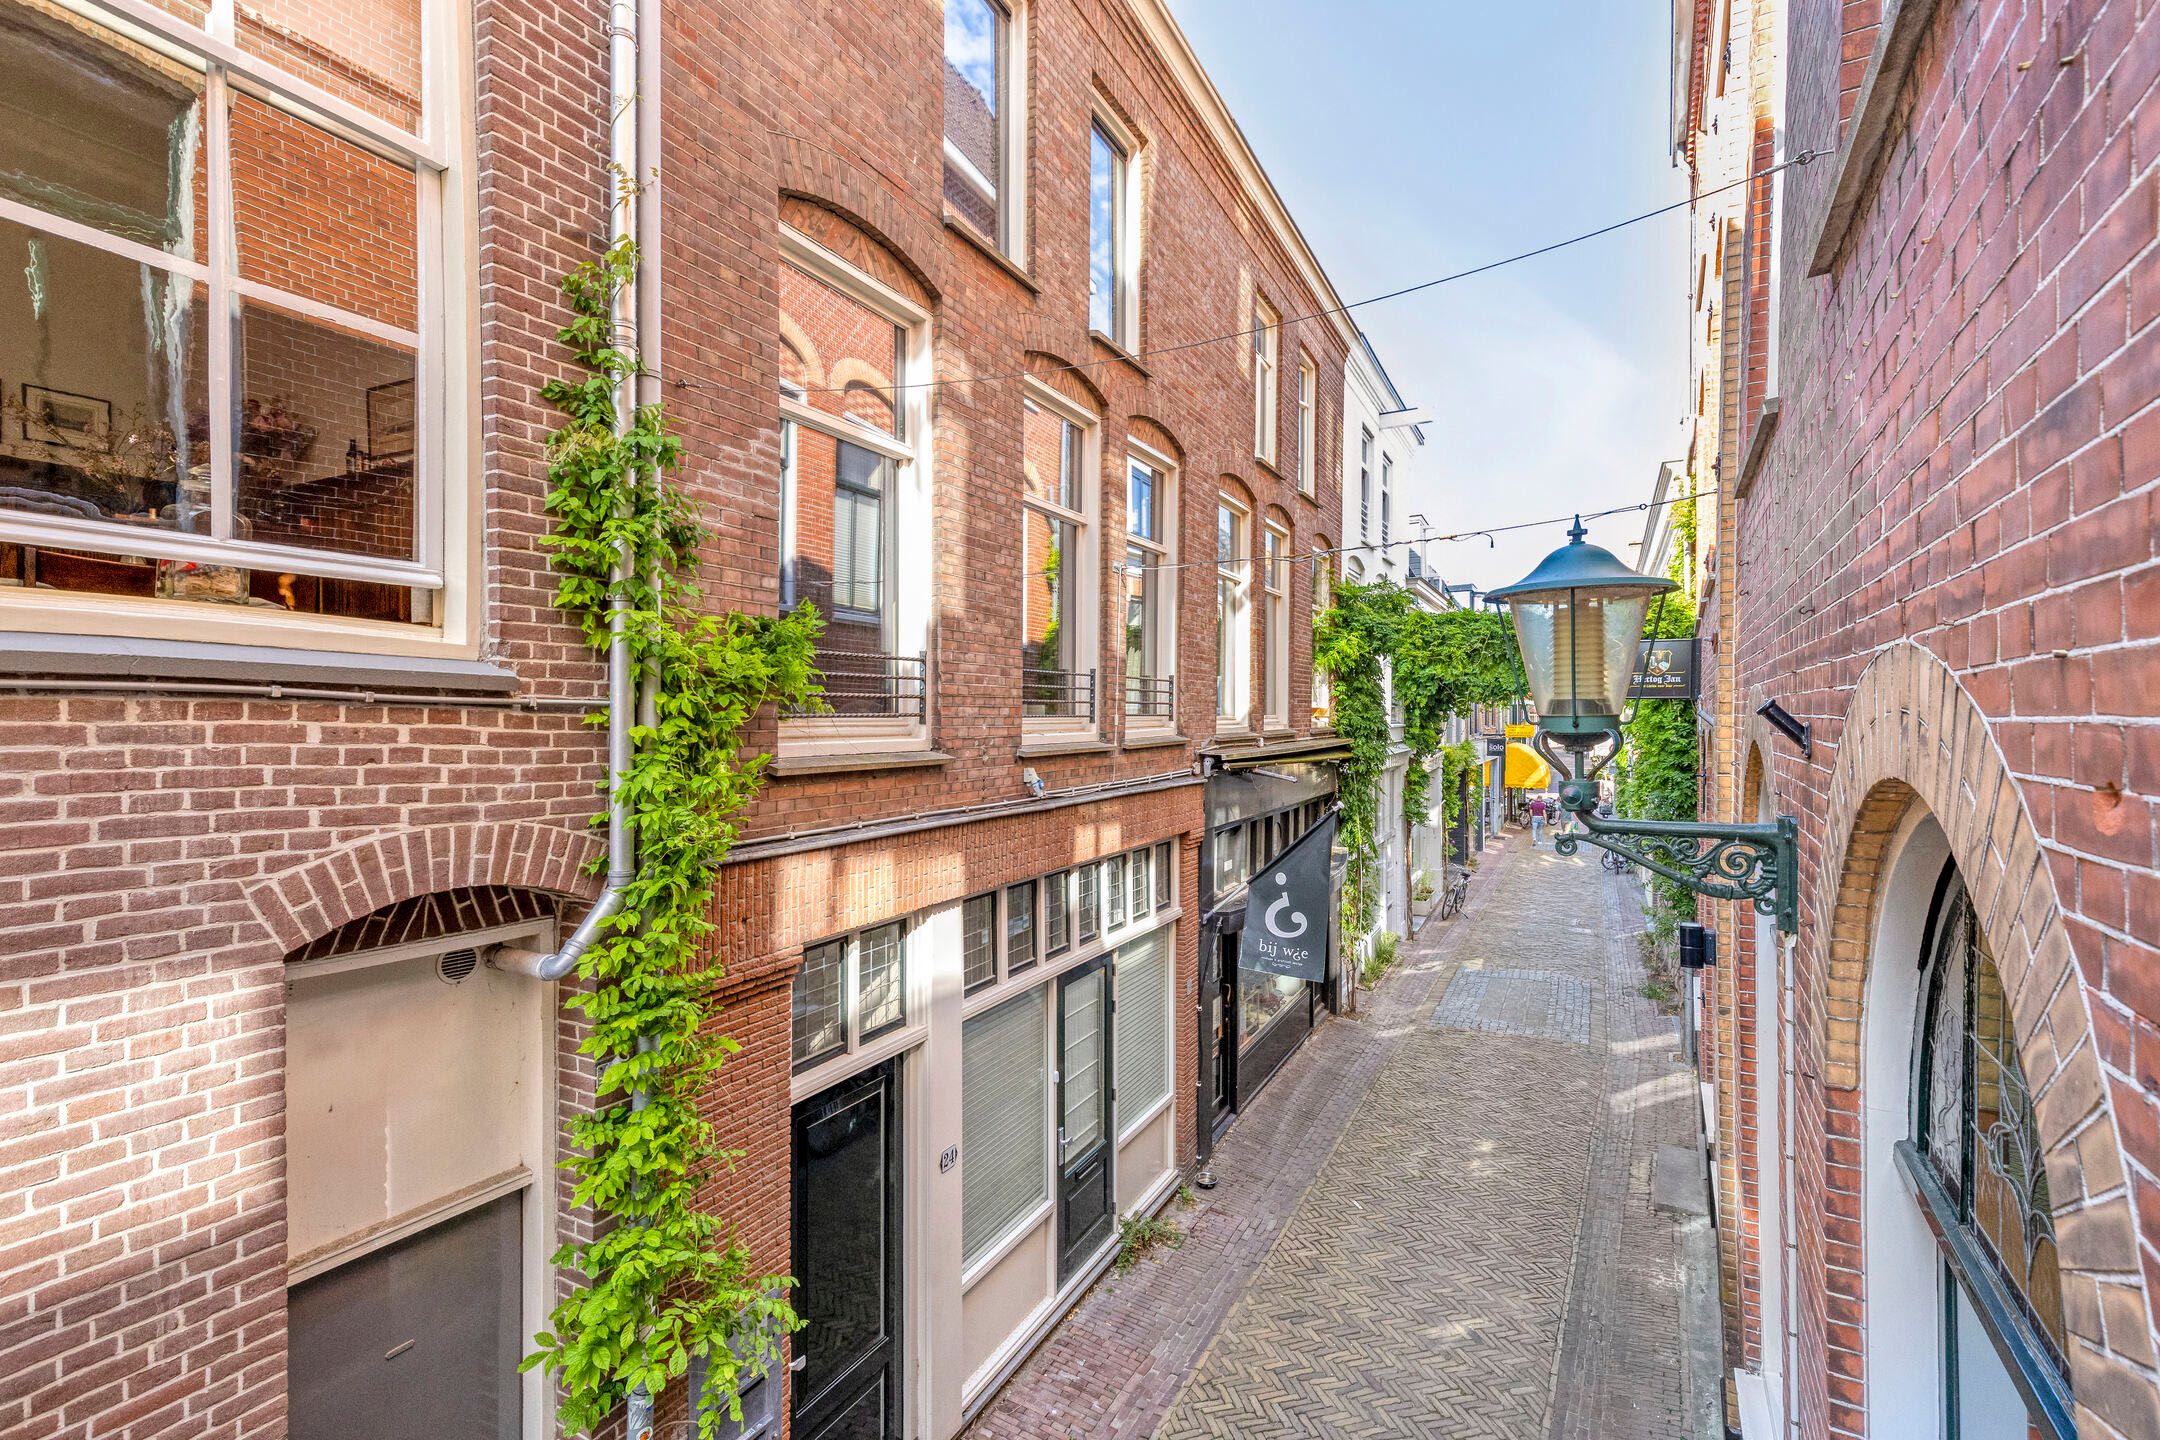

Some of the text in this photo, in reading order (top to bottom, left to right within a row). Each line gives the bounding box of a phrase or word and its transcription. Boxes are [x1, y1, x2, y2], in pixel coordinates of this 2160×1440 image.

[1664, 675, 1681, 684] Jan
[1259, 939, 1278, 957] bij
[943, 1149, 955, 1168] 24
